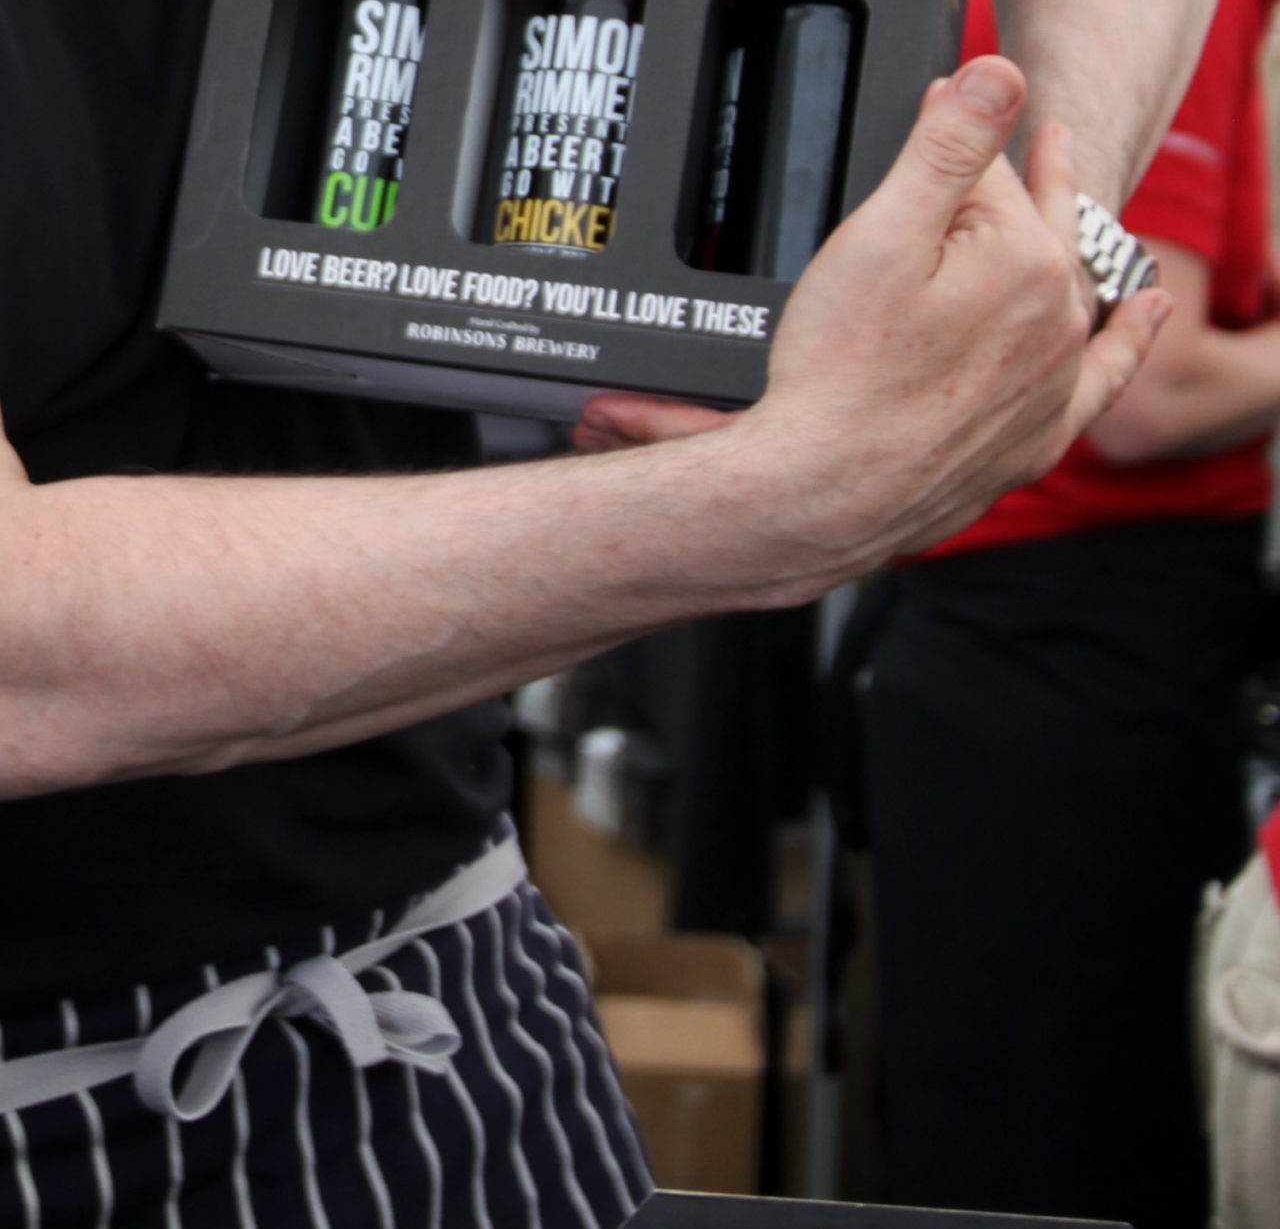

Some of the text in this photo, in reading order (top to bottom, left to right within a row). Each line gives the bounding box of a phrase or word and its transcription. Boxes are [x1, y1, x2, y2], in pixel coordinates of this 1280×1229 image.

[513, 70, 637, 123] RIMME
[334, 116, 352, 148] A
[330, 148, 369, 173] GO
[504, 136, 519, 168] A
[522, 134, 604, 173] BEER
[500, 169, 532, 198] GO
[495, 198, 617, 252] CHICKE
[257, 246, 770, 338] LOVE BEER? LOVE FOOD? YOU'LL LOVE THESE
[405, 321, 601, 361] ROBINSONS BREWERY
